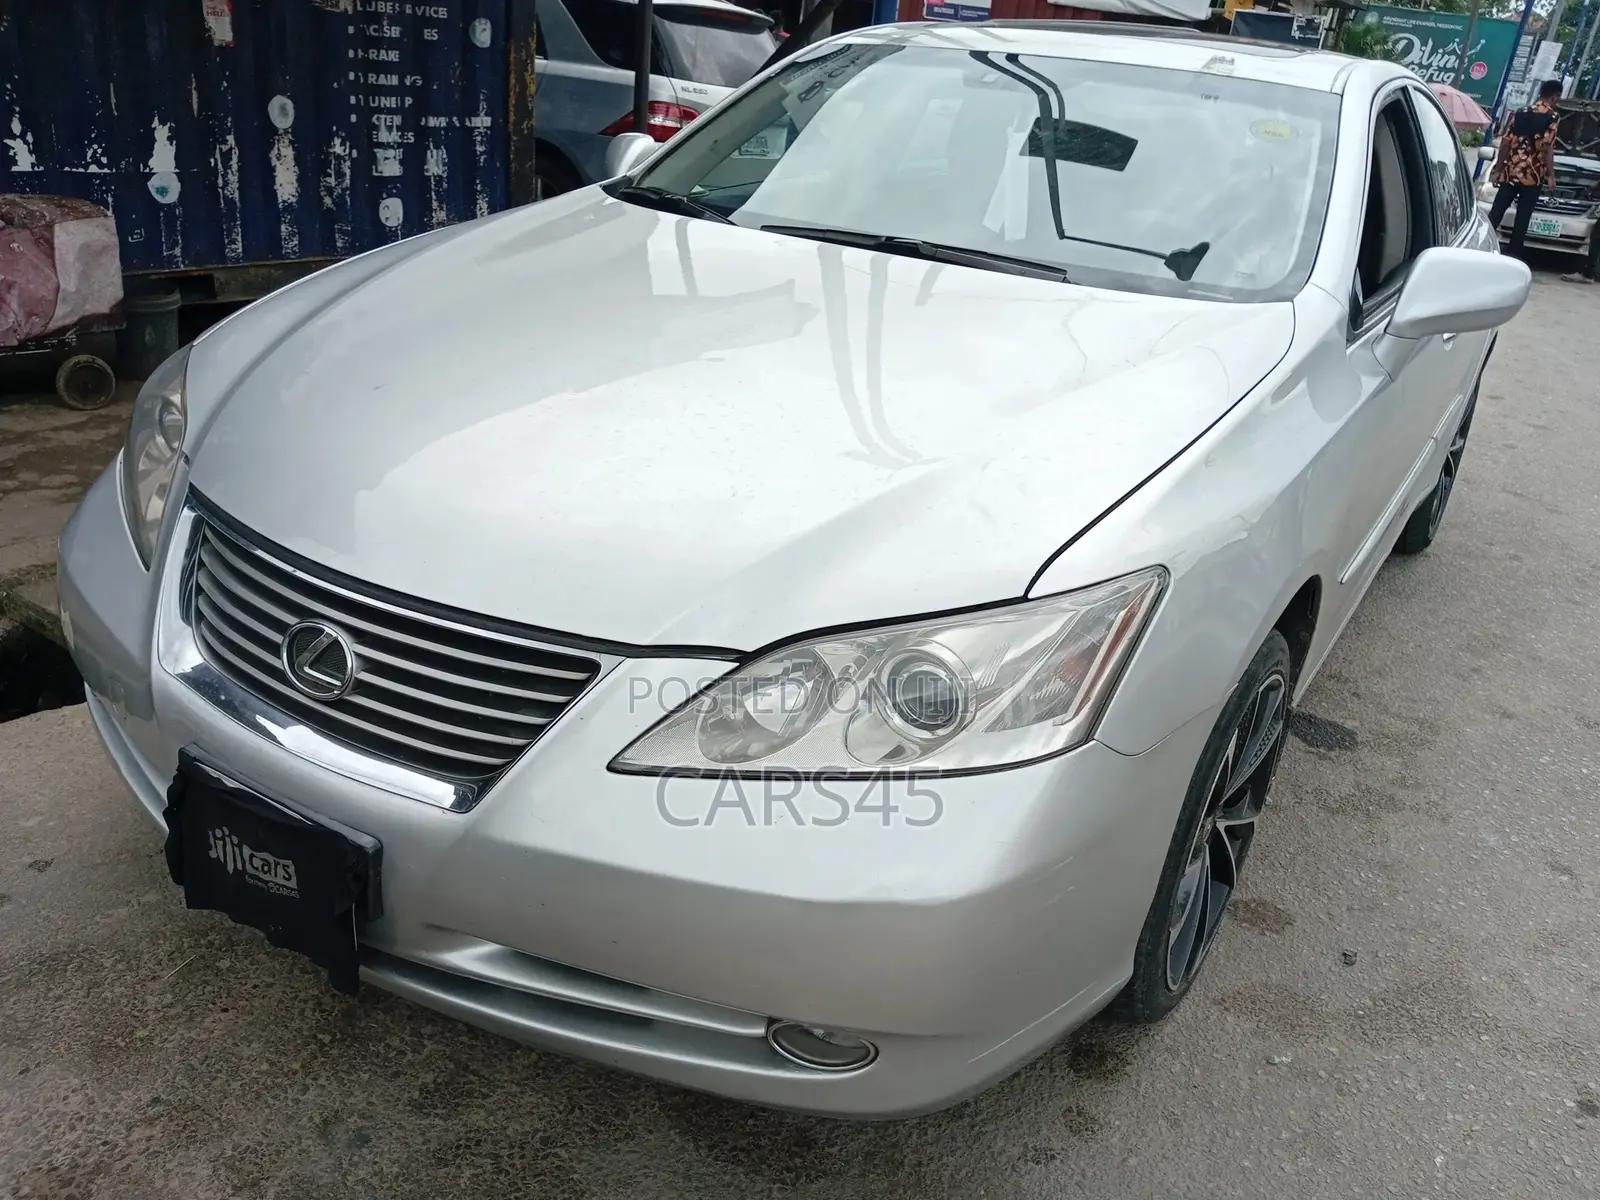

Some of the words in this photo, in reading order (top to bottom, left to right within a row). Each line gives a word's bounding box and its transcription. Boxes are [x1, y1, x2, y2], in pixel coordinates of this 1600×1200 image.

[395, 3, 448, 18] SRVICES
[1407, 64, 1464, 84] Refug
[248, 852, 293, 882] cars
